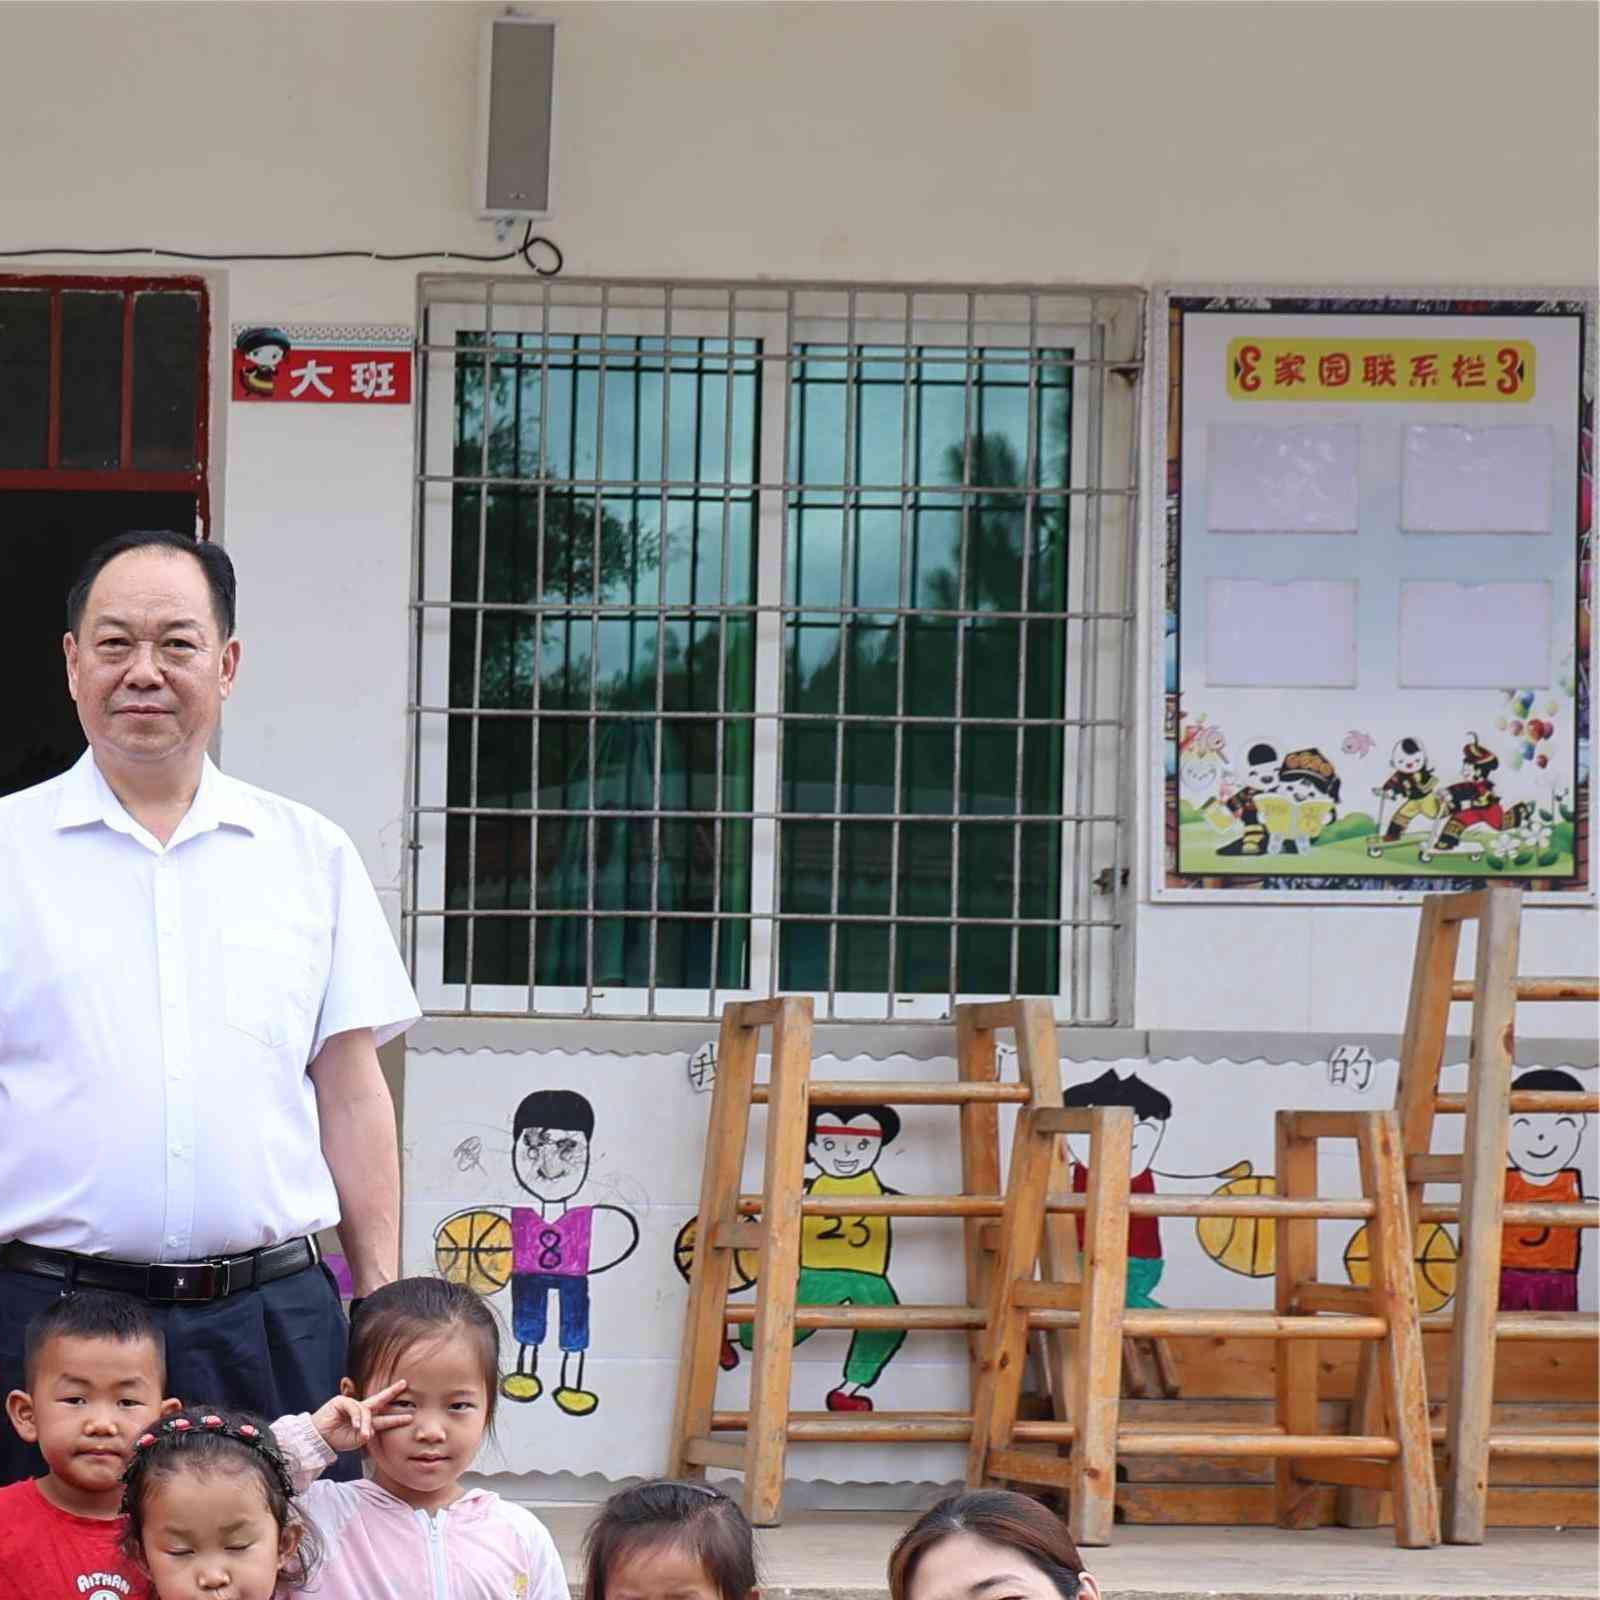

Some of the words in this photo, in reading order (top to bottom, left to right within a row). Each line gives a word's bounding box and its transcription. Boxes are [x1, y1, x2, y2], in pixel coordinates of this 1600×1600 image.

[290, 359, 396, 399] 大班
[1274, 352, 1487, 388] 家园联系栏
[1331, 1047, 1373, 1090] 的
[539, 1230, 561, 1269] 8
[817, 1216, 871, 1248] 23
